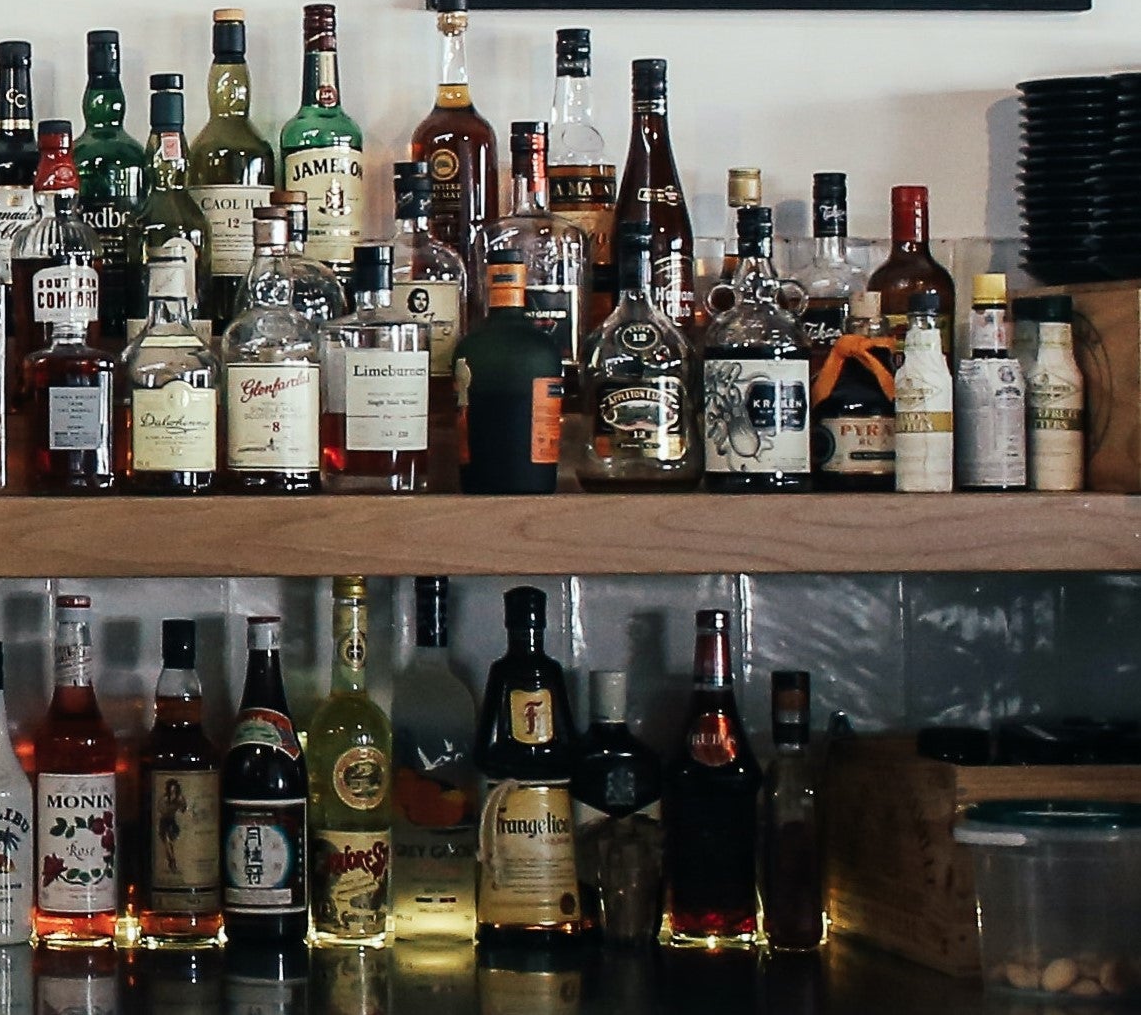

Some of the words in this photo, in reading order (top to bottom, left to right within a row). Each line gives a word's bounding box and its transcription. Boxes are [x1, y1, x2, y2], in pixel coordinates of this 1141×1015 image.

[200, 196, 241, 211] CAOL
[272, 421, 281, 433] 8
[47, 794, 113, 809] MONIN
